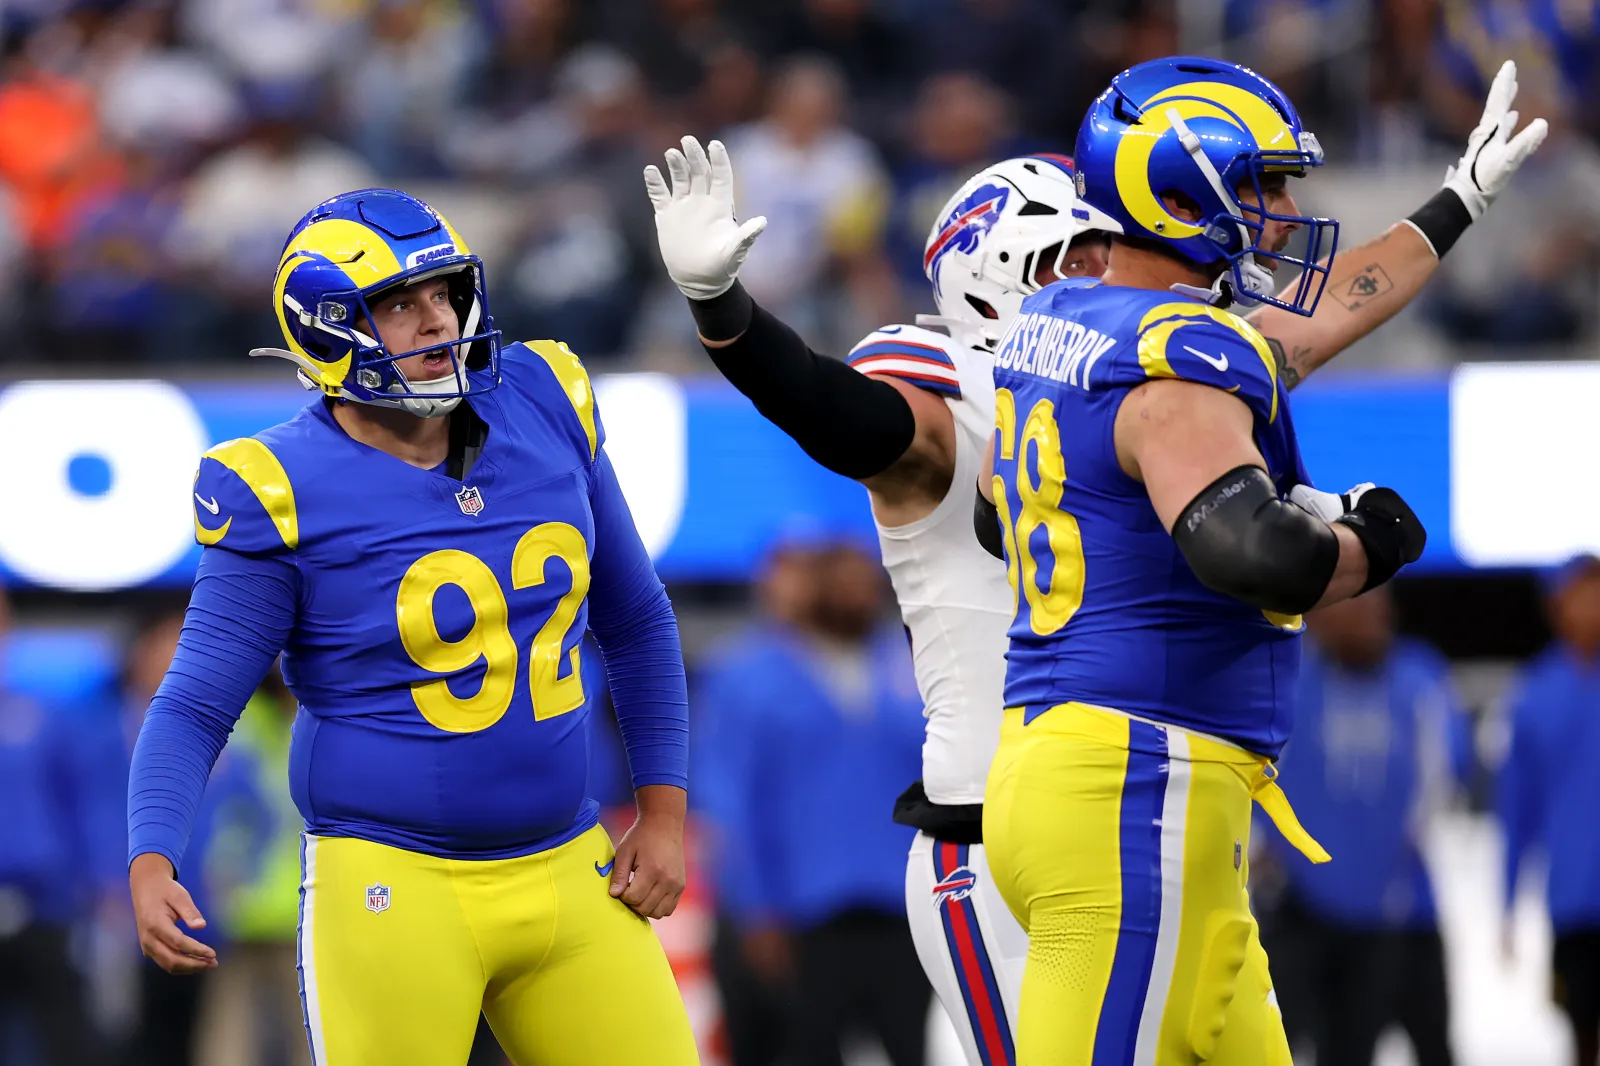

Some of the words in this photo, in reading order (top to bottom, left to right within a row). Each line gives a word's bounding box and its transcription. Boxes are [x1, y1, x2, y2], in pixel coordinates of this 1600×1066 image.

[416, 245, 455, 265] RAMS
[995, 312, 1117, 391] ESSENBERRY
[462, 498, 481, 511] NFL
[396, 521, 591, 733] 92
[370, 896, 386, 908] NFL
